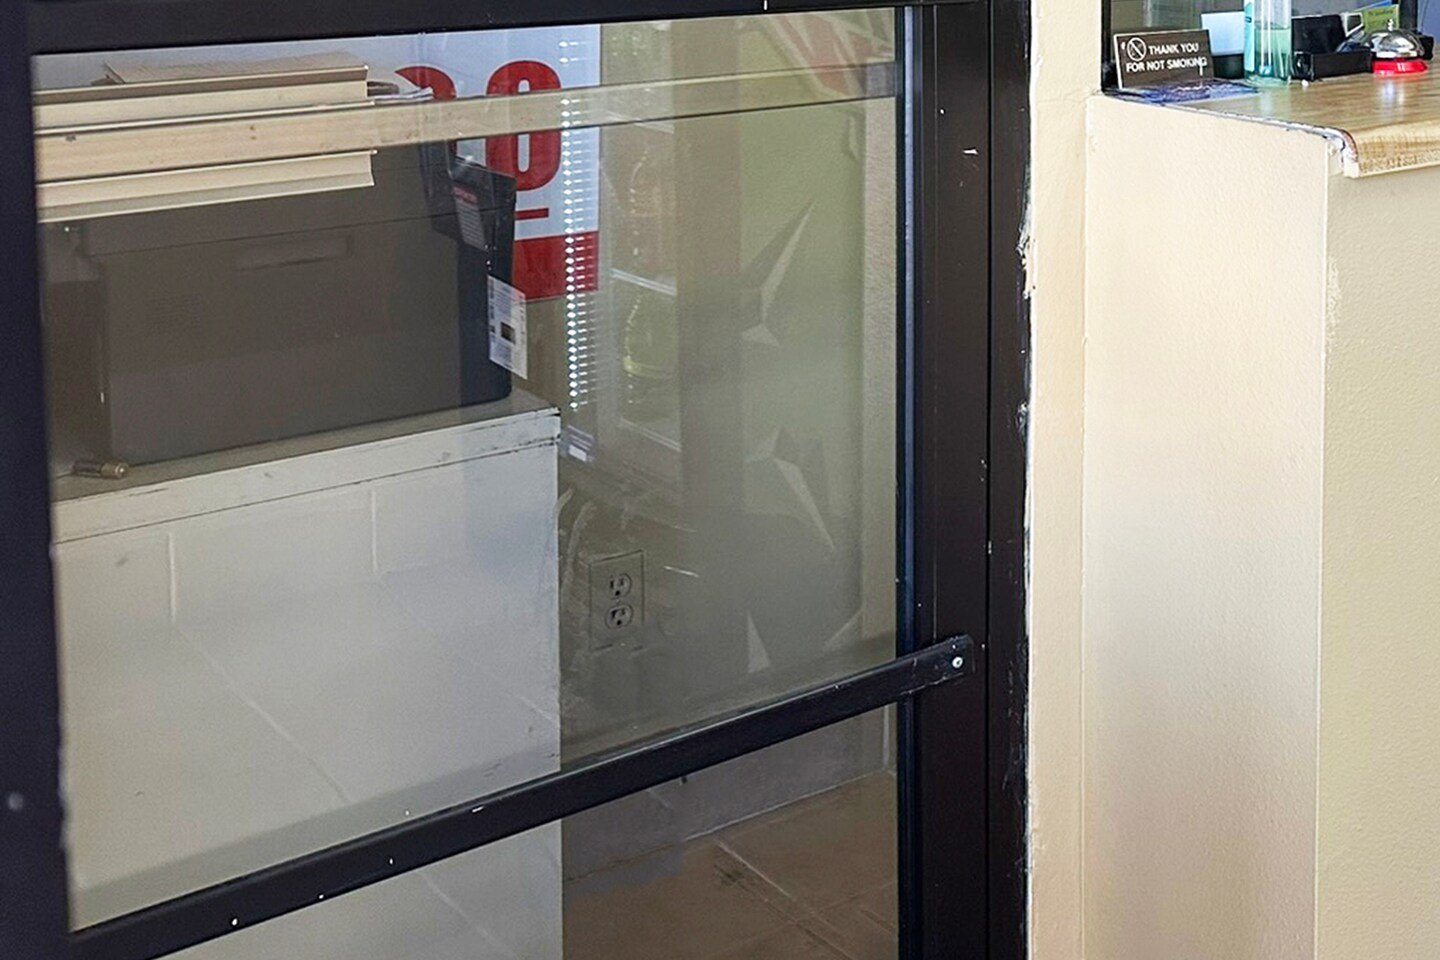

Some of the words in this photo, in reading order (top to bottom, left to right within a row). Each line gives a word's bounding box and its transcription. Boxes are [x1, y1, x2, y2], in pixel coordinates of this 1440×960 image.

[1148, 43, 1179, 55] THANK
[1180, 42, 1200, 53] YOU
[1126, 62, 1145, 73] FOR
[1146, 59, 1166, 71] NOT
[1166, 56, 1208, 70] SMOKING
